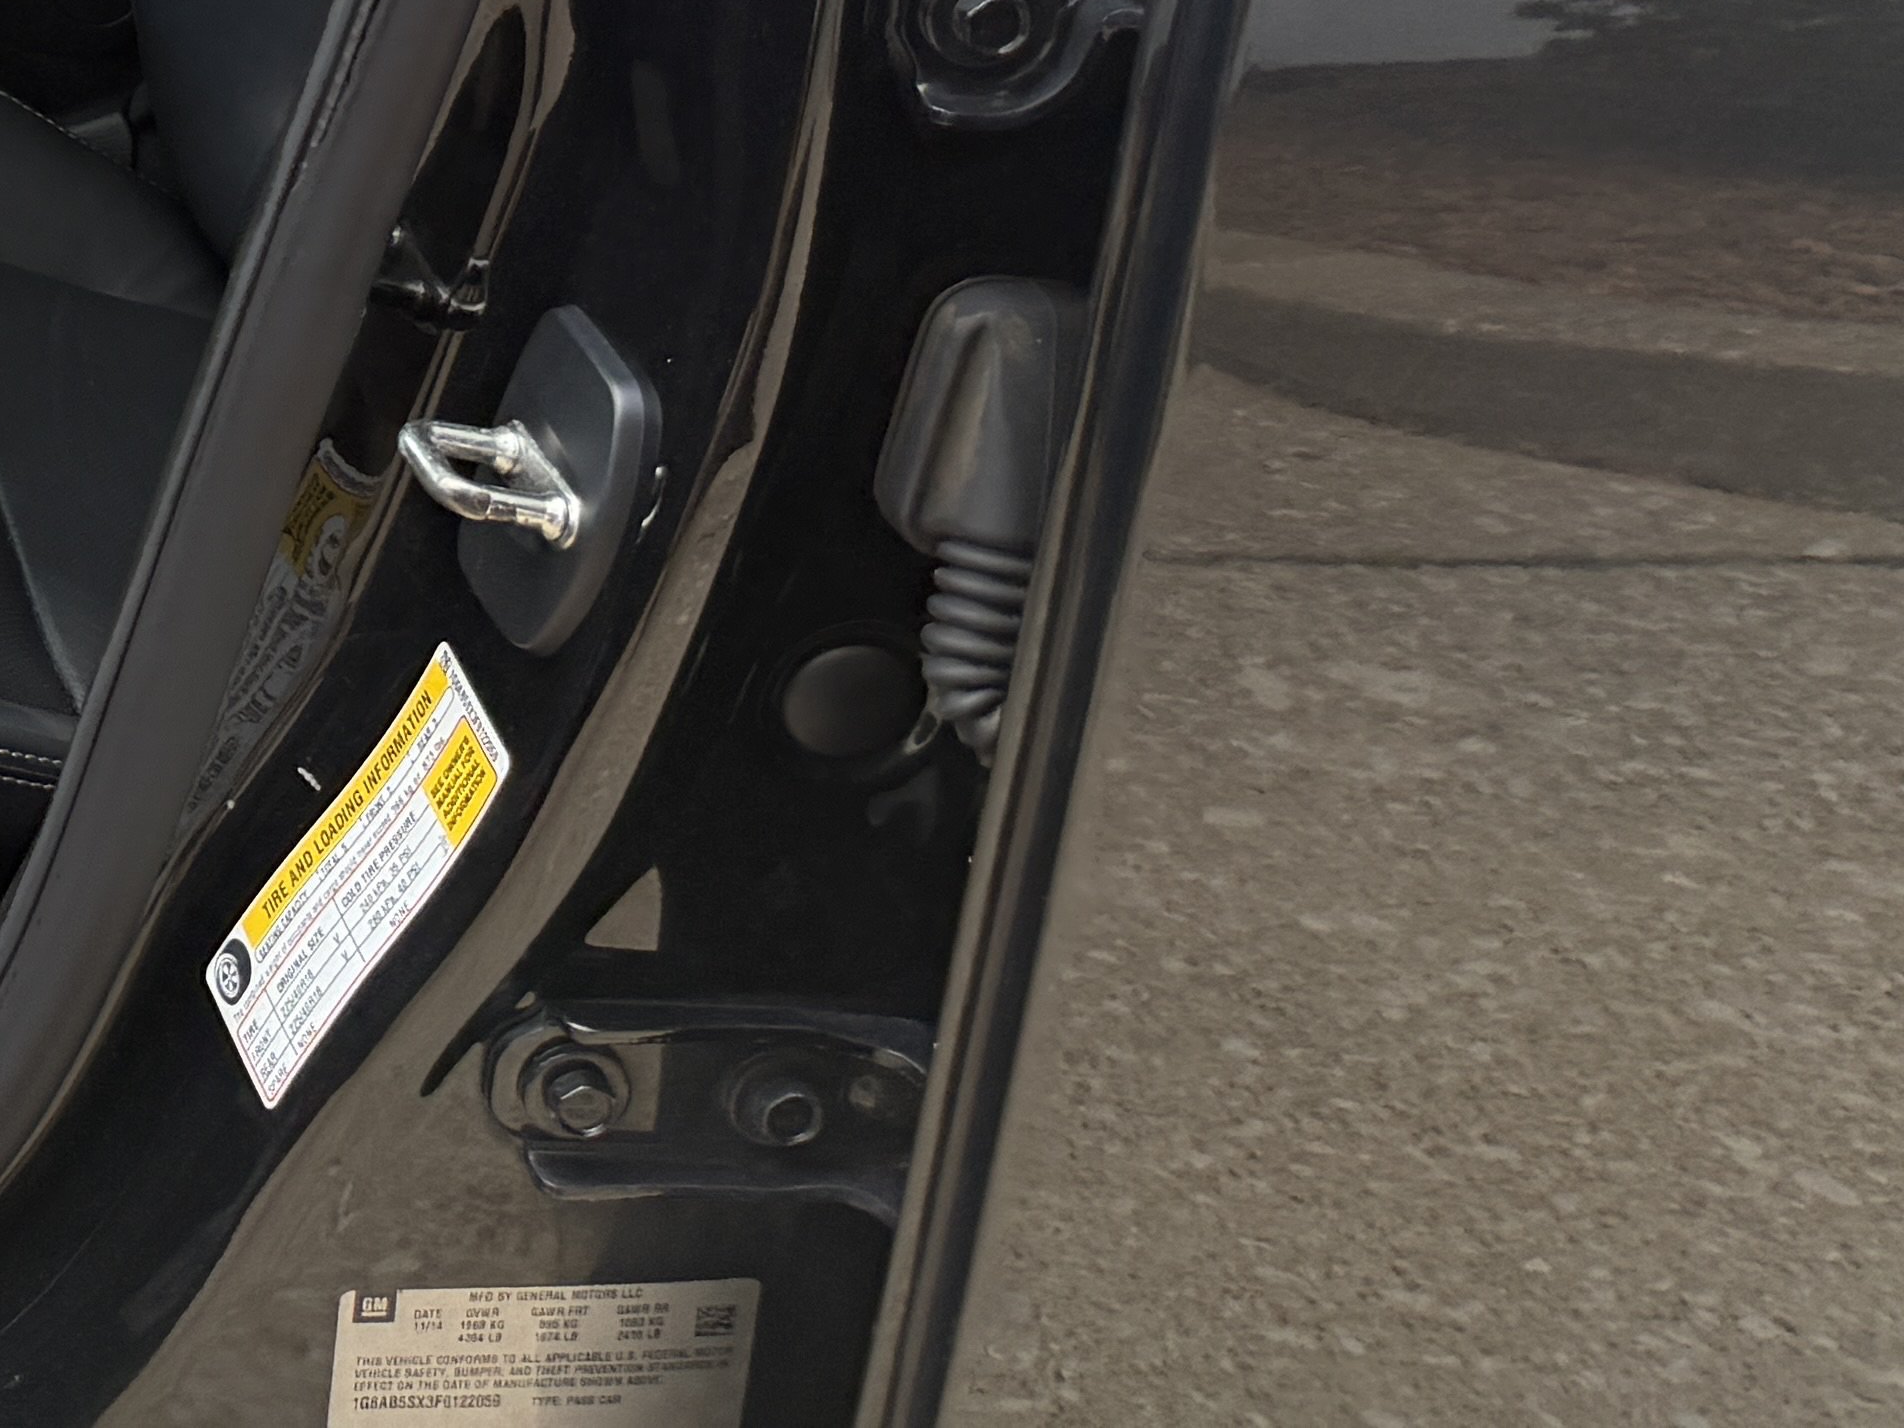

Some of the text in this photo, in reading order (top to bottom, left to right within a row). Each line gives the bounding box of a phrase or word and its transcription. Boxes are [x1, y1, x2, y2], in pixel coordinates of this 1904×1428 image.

[262, 689, 433, 918] TIRE AND LOADING INFORMATION
[341, 879, 362, 907] COLD
[360, 858, 379, 883] TIRE
[378, 810, 417, 862] PRESSURE
[516, 1290, 566, 1301] GENERAL
[571, 1289, 618, 1300] MOTORS
[622, 1287, 643, 1299] LLC
[362, 1297, 388, 1311] GM
[414, 1309, 442, 1319] DATE
[385, 1355, 432, 1366] VEHICLE
[436, 1354, 498, 1365] CONFORMS
